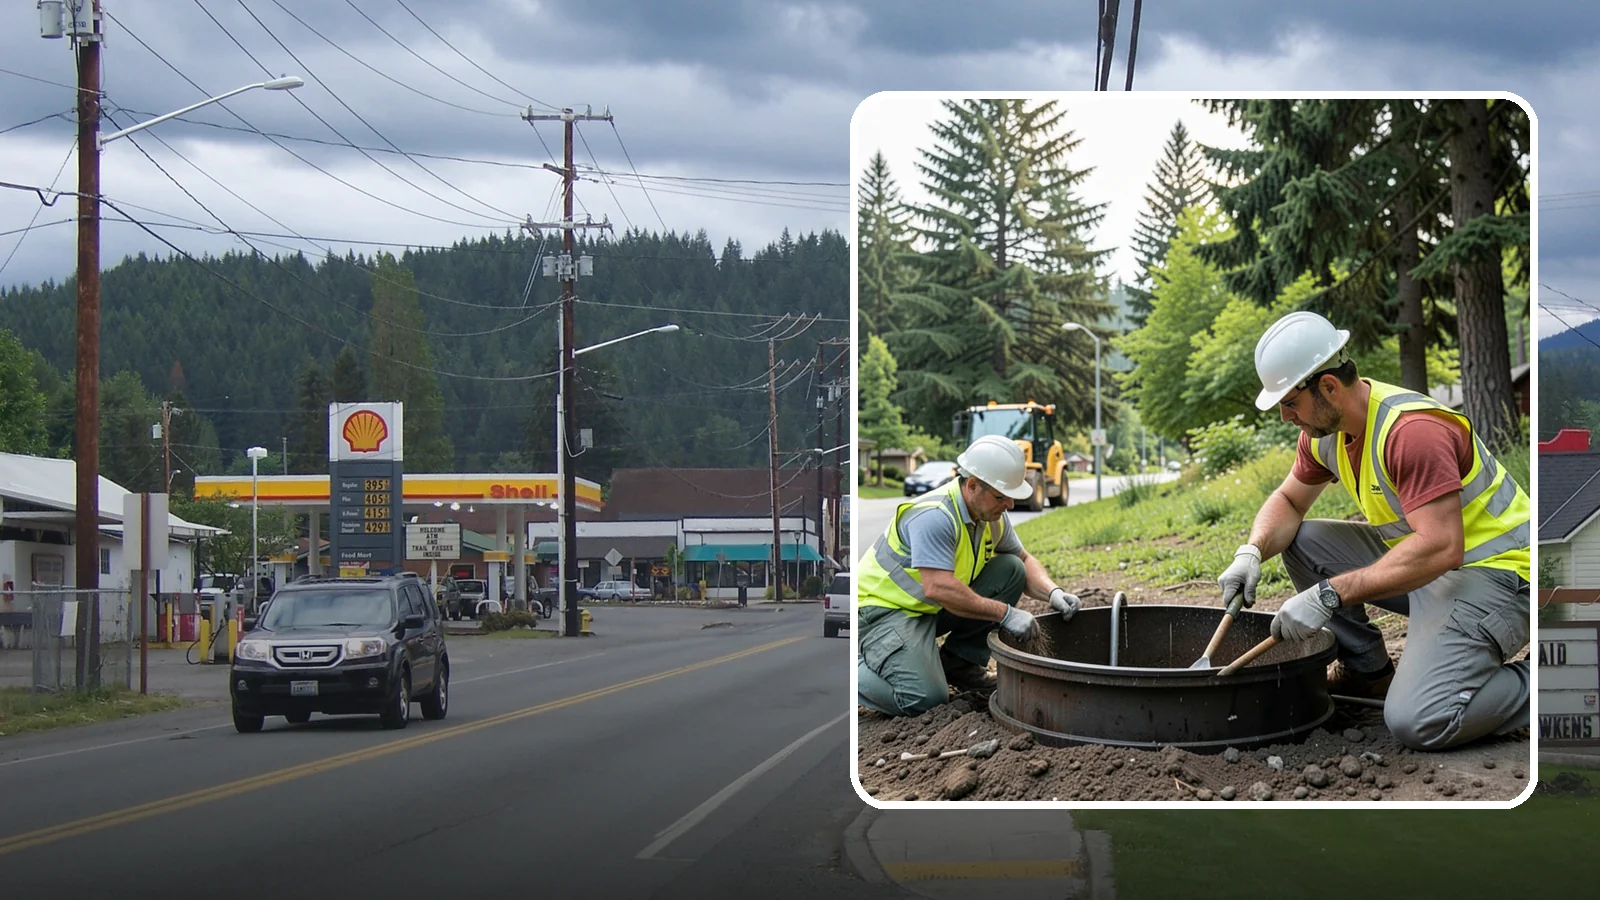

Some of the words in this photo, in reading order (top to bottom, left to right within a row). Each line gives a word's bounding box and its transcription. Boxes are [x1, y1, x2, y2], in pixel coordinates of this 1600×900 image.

[366, 480, 383, 490] 395
[490, 484, 548, 499] Shell
[366, 494, 383, 504] 405
[366, 508, 383, 518] 415
[366, 522, 383, 533] 429
[1538, 643, 1567, 665] AID
